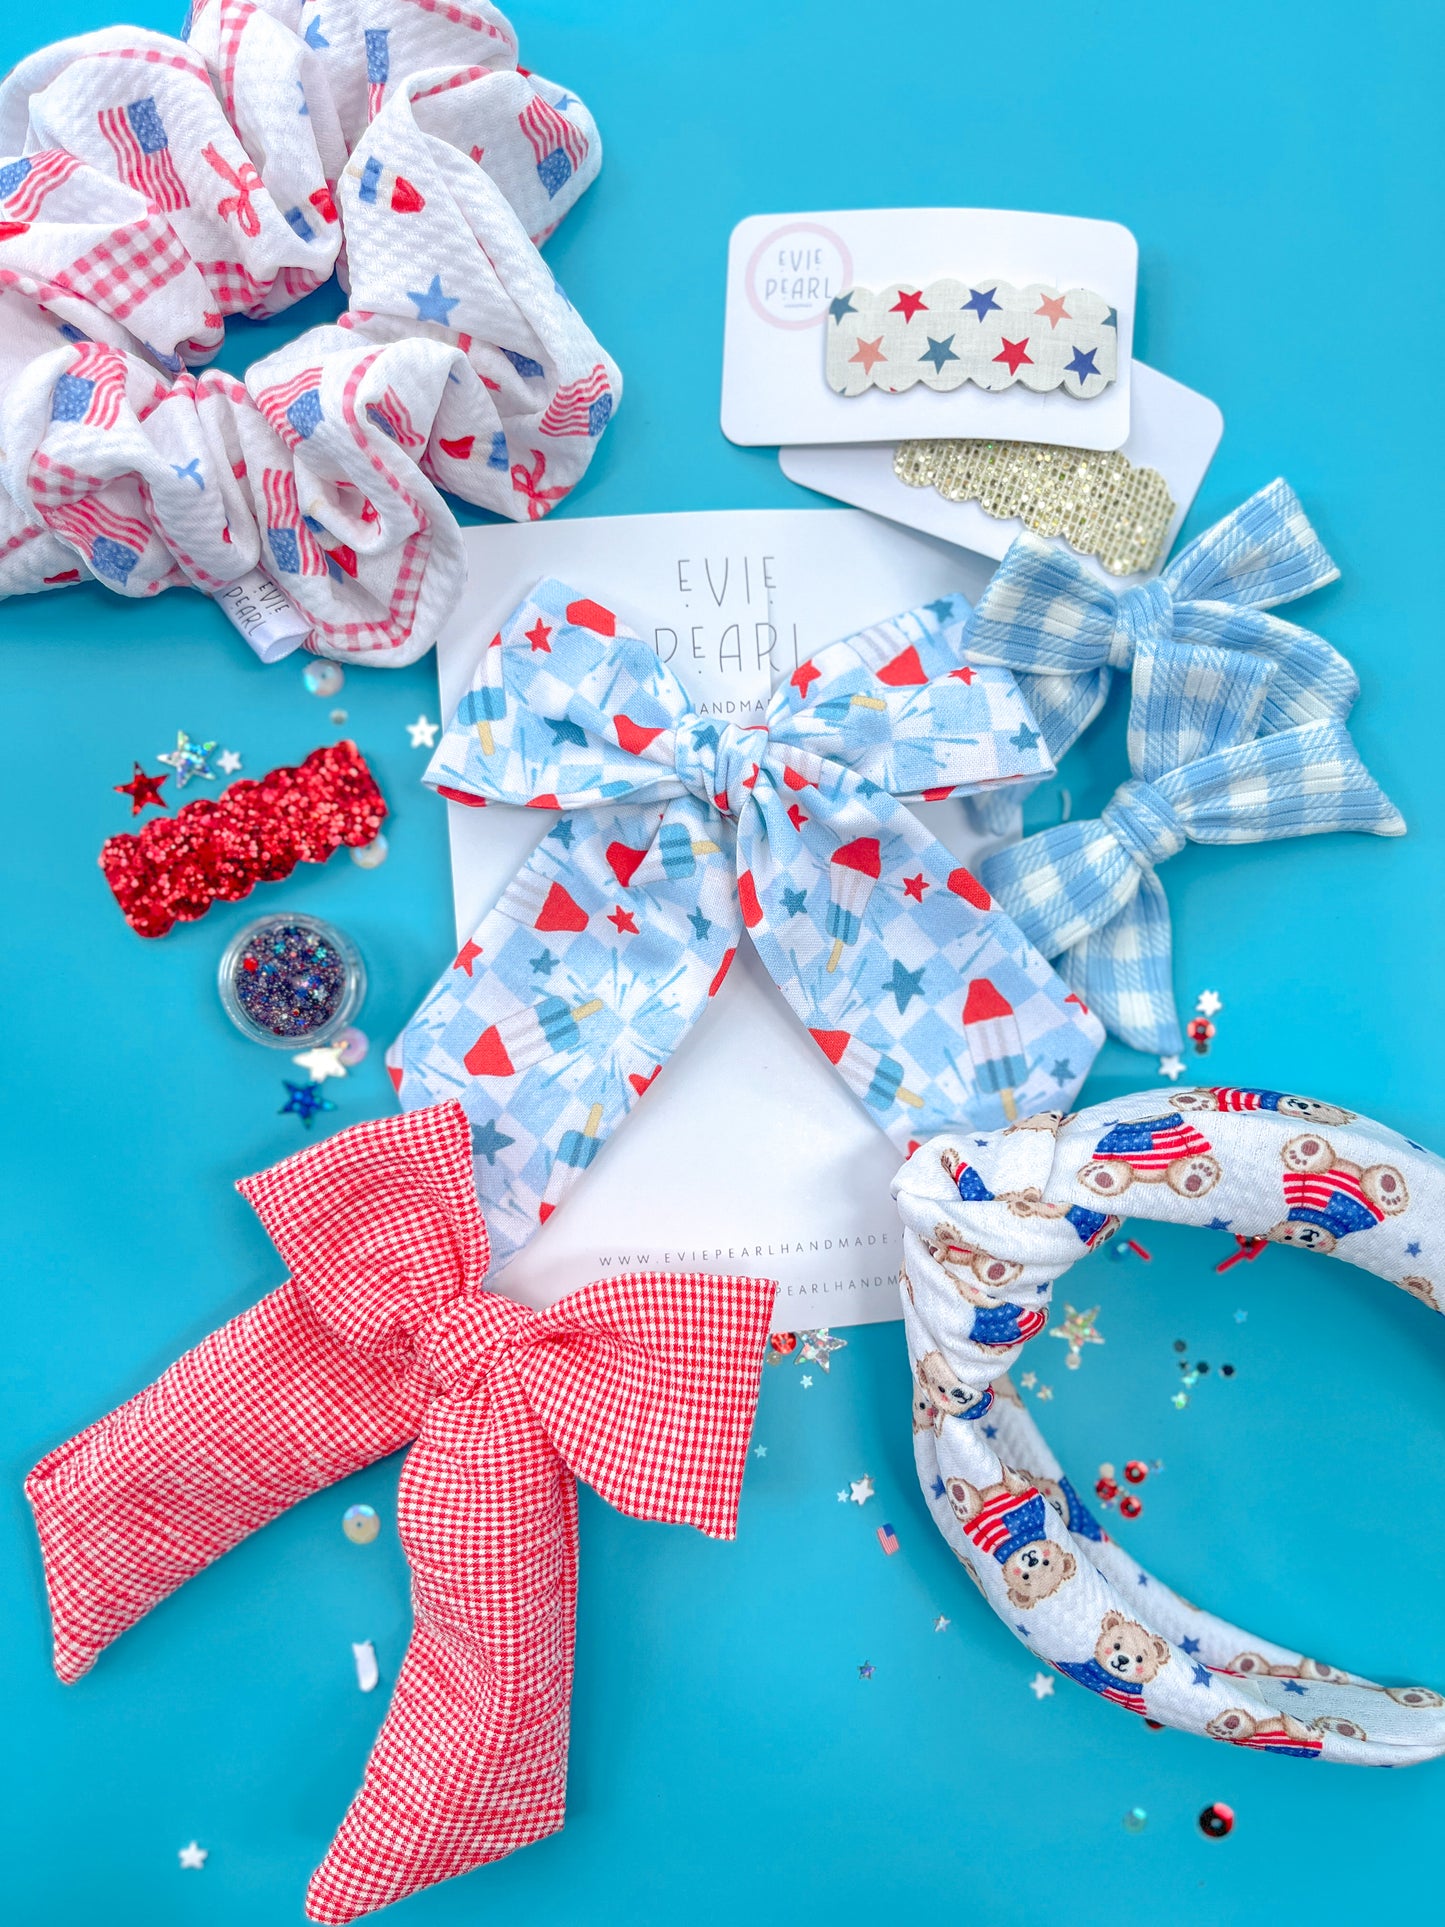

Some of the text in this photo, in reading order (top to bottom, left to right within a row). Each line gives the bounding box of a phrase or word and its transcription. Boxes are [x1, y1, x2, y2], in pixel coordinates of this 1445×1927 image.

[778, 249, 822, 272] EVIE
[765, 277, 833, 300] PEARL
[678, 556, 777, 607] EVIE
[223, 586, 266, 637] PEARL
[254, 581, 290, 615] EVIE
[694, 698, 771, 714] ANDMA
[599, 1232, 904, 1266] WWW.EVIEPEARLHANDMADE.
[775, 1275, 899, 1297] PEARLHANDM
